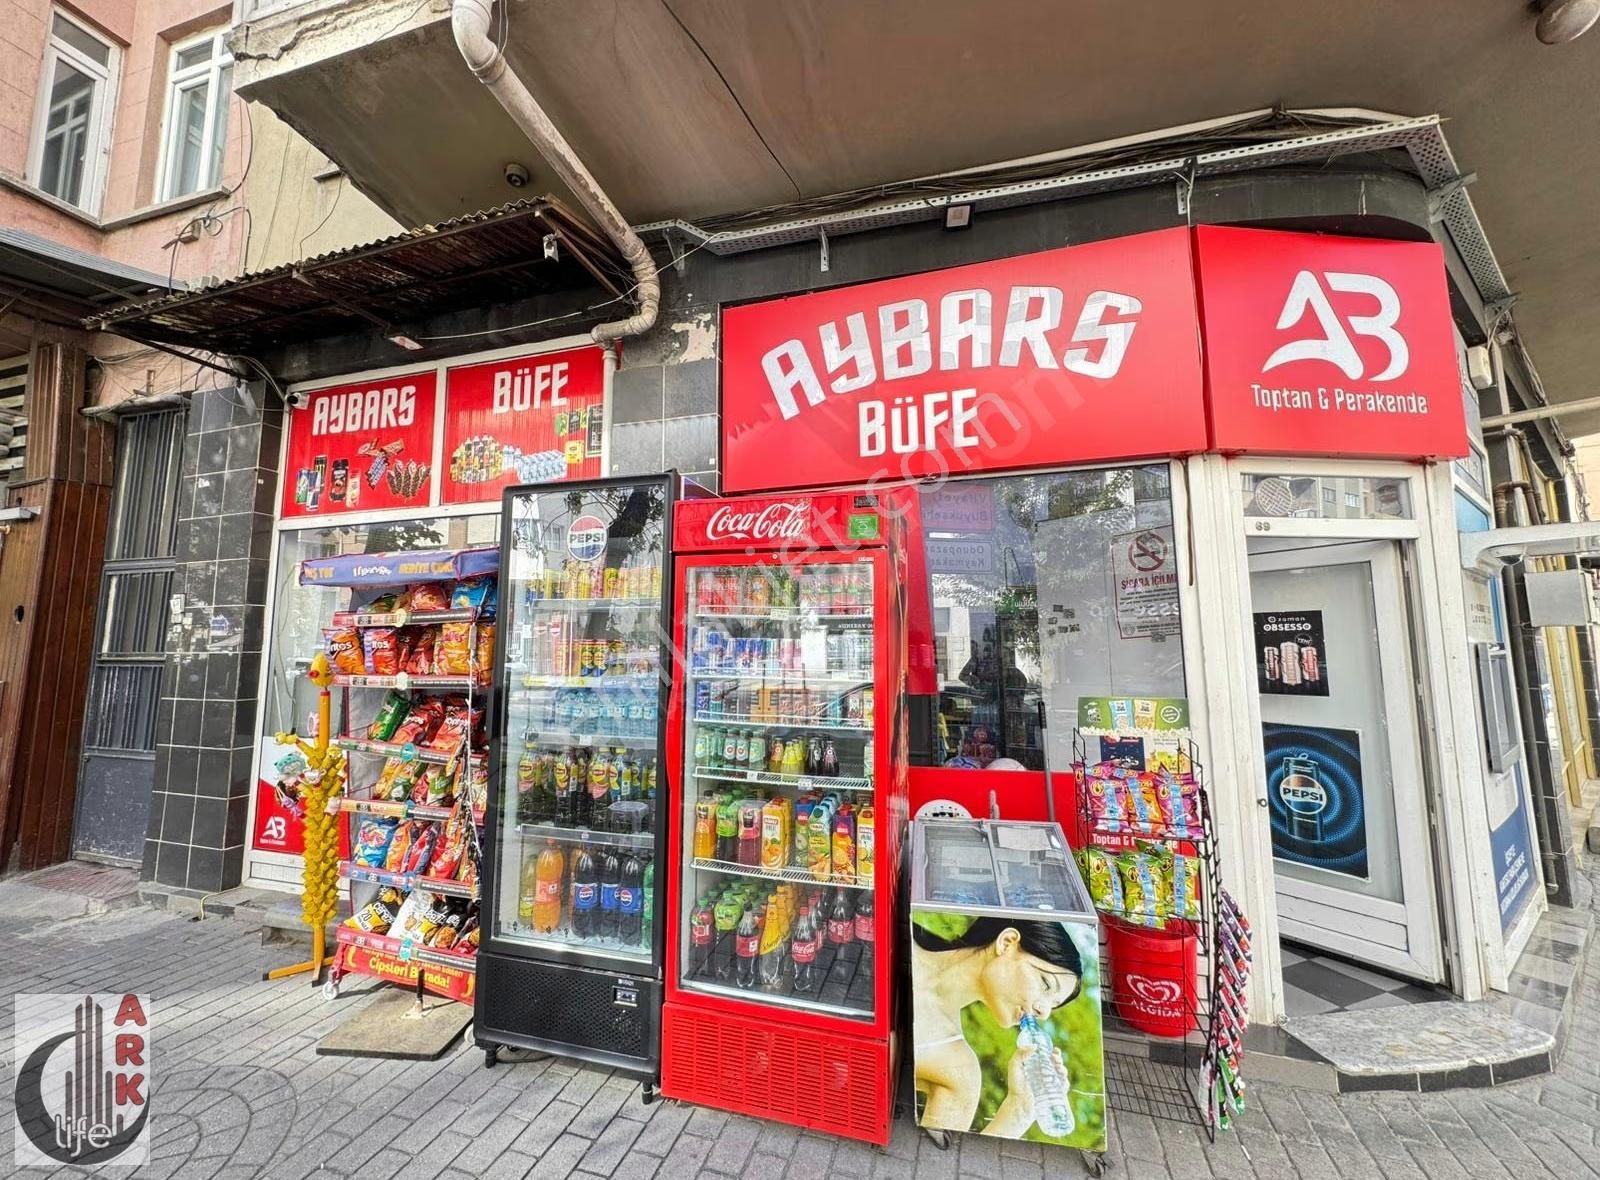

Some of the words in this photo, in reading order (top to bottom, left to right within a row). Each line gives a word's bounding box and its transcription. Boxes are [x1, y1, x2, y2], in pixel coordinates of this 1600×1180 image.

[1262, 270, 1409, 382] AB
[761, 285, 1143, 420] AYBARS
[493, 362, 569, 414] BÜFE
[1251, 384, 1312, 412] Toptan
[1318, 388, 1329, 410] &
[1334, 388, 1429, 414] Perakende
[312, 385, 416, 436] AYBARS
[859, 388, 979, 457] BÜFE
[706, 502, 809, 541] Coca-Cola
[569, 532, 604, 544] PEPSI
[1263, 622, 1312, 631] OBSESSO
[1282, 786, 1324, 802] PEPSI
[262, 816, 286, 840] AB
[1092, 832, 1121, 846] Toptan
[409, 969, 450, 989] Brada!
